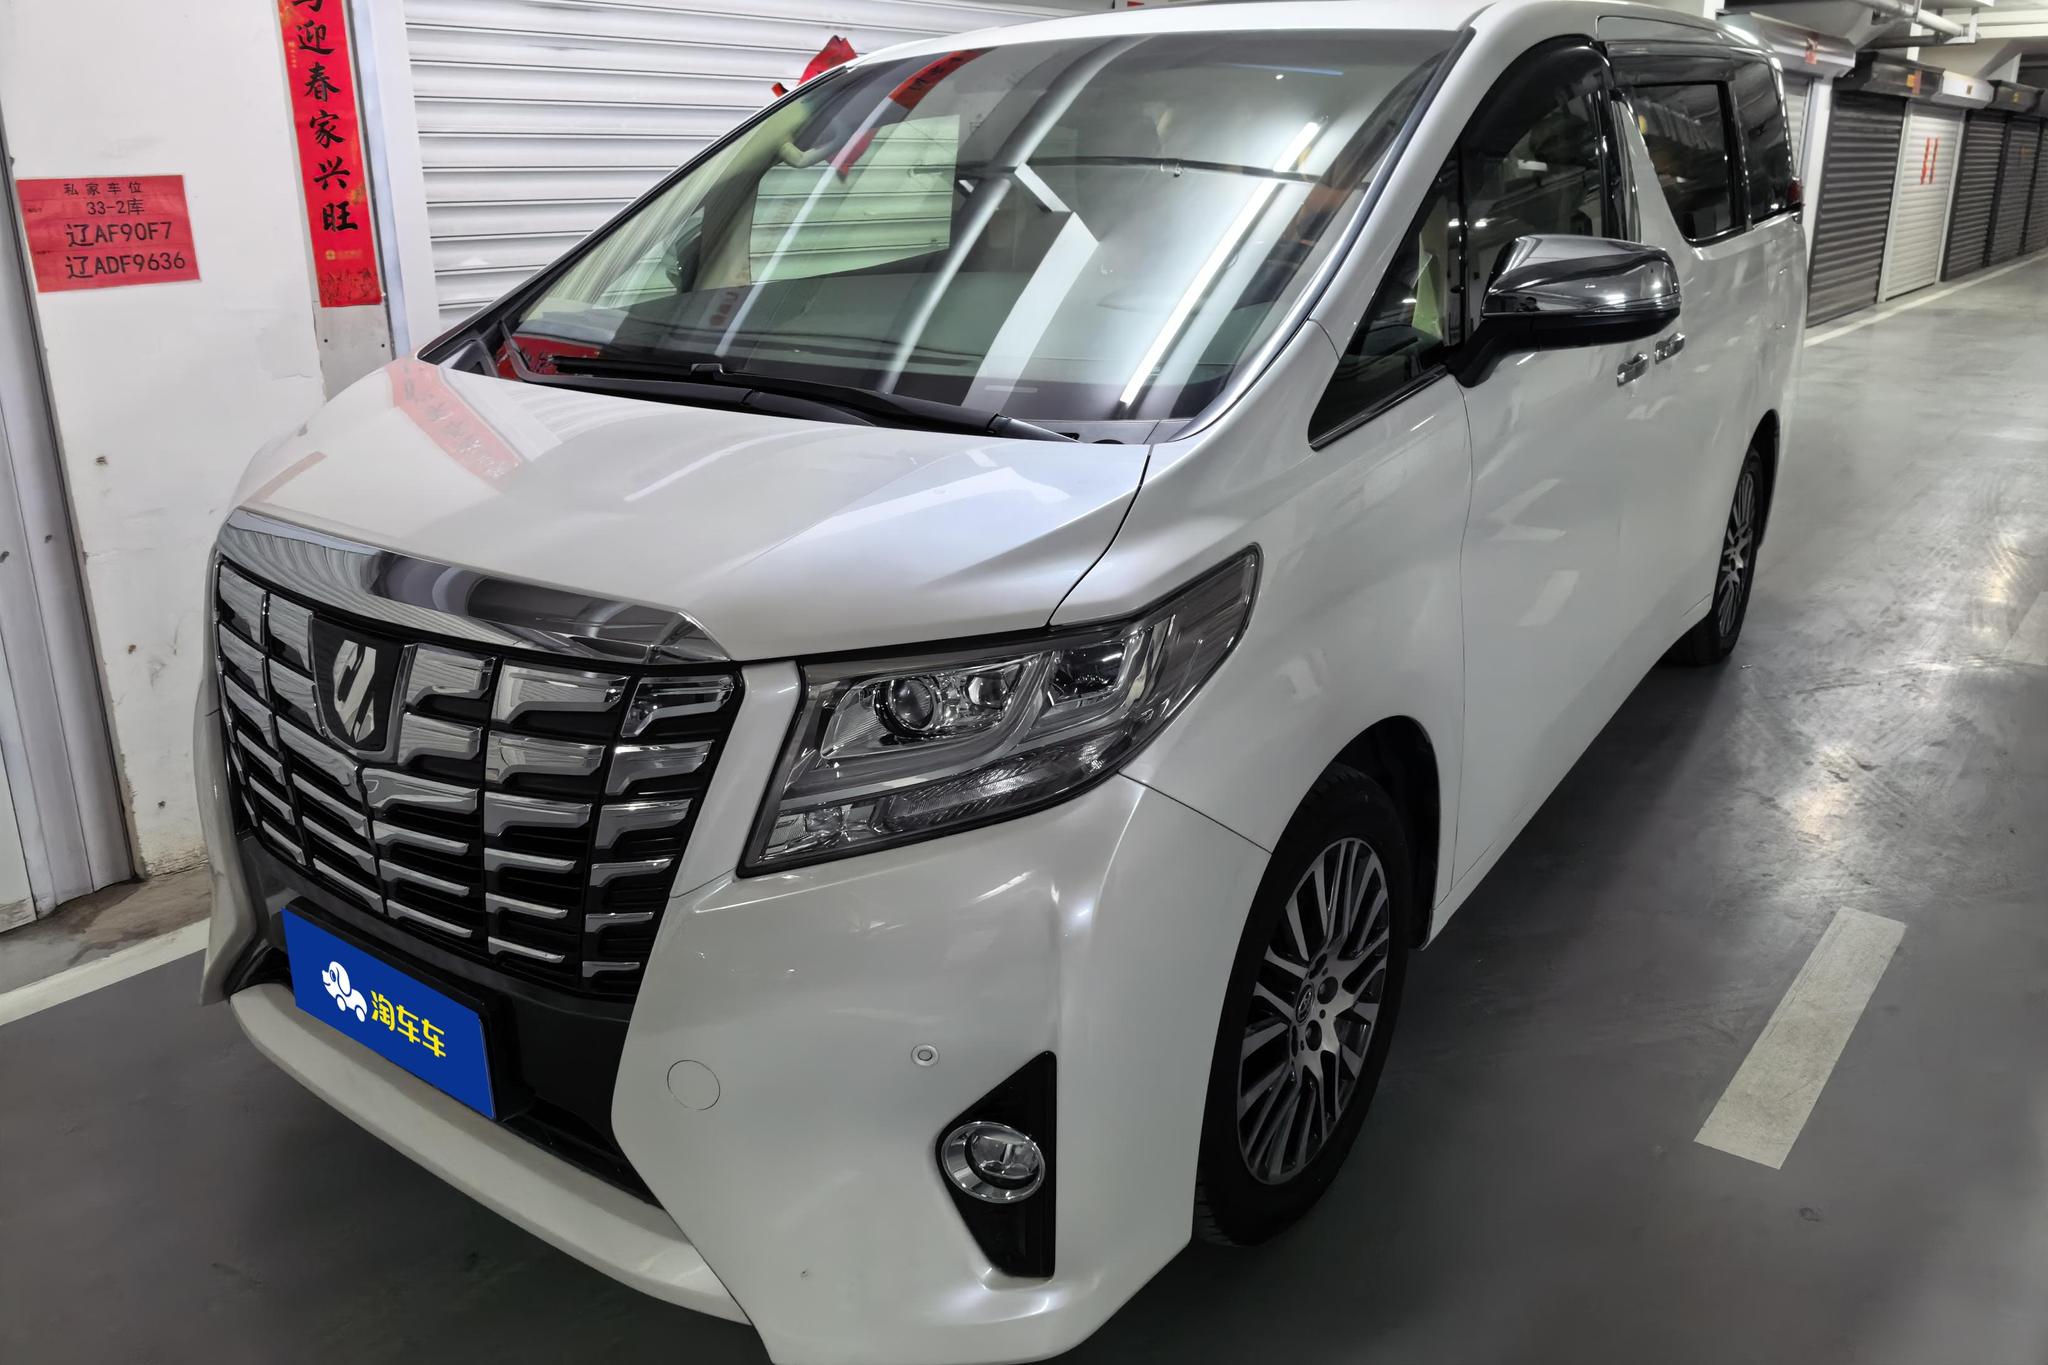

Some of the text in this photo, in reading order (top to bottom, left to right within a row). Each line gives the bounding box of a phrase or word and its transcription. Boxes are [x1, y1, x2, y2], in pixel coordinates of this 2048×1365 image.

[63, 181, 145, 196] 私家车位
[87, 198, 145, 216] 33-2库
[65, 221, 172, 247] 辽AF90F7
[65, 252, 186, 279] 辽ADF9636
